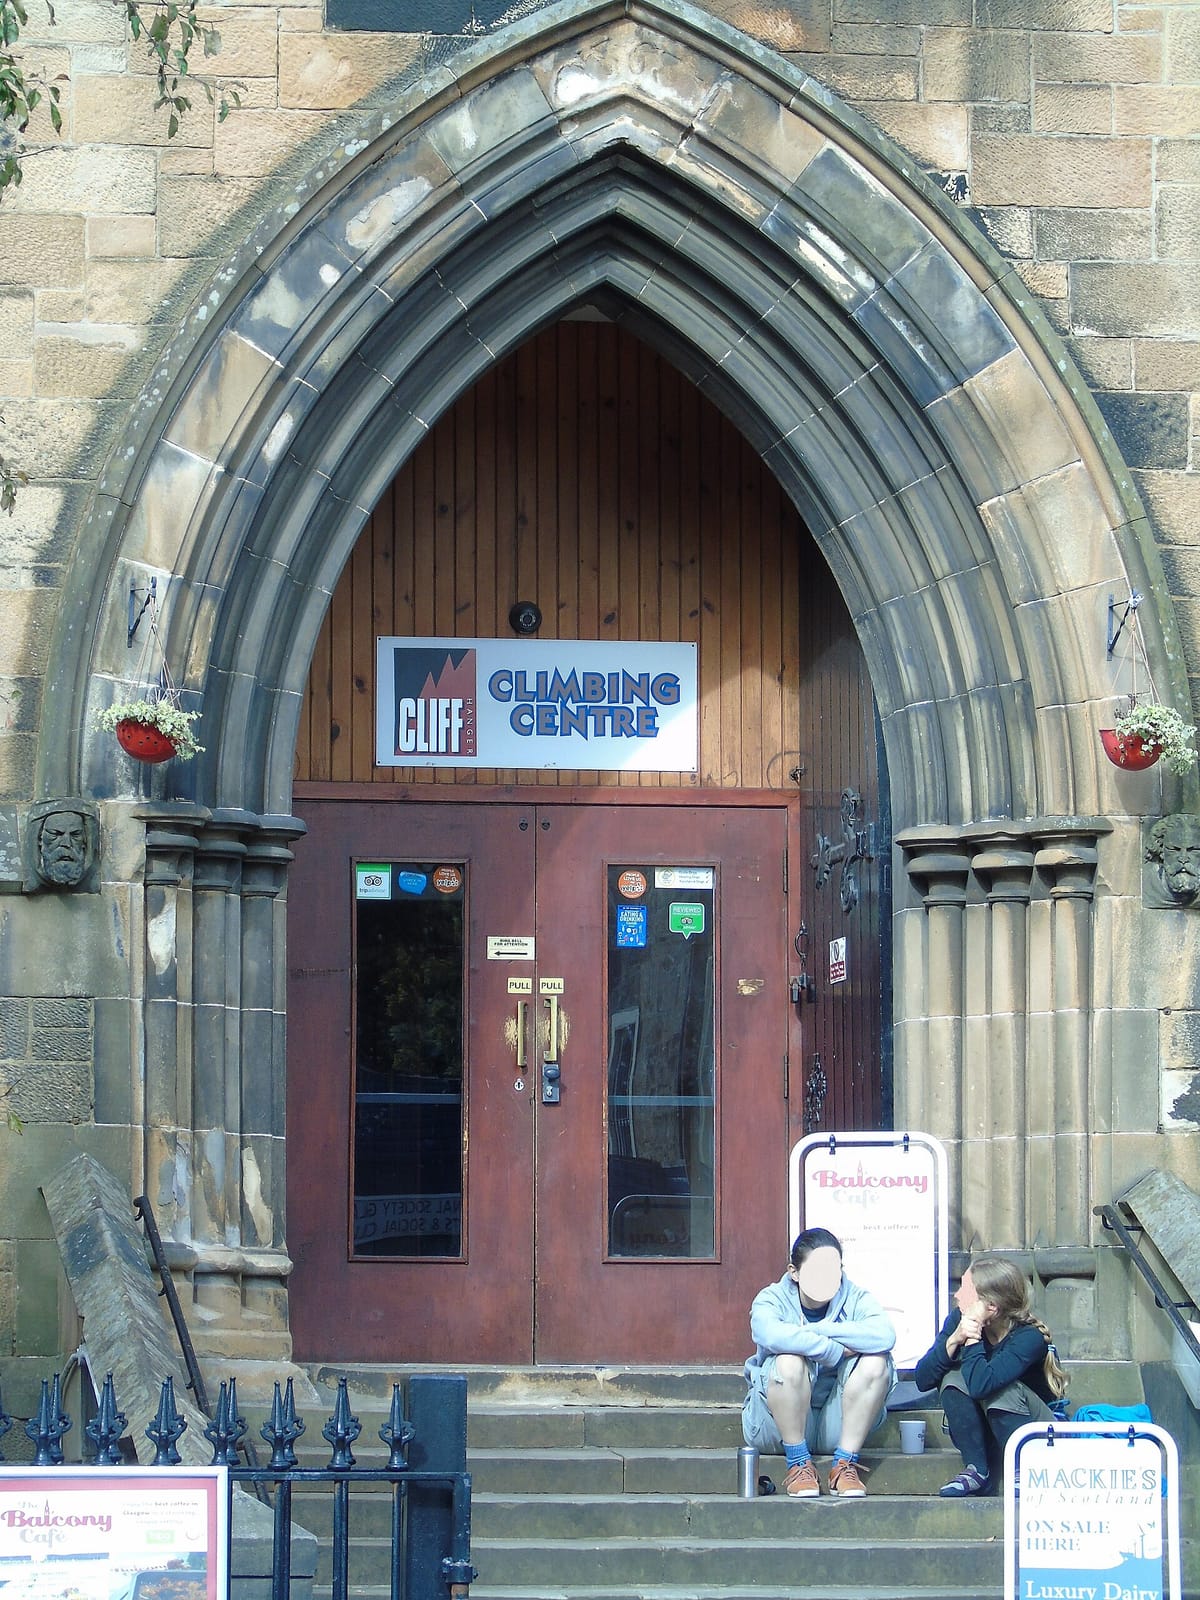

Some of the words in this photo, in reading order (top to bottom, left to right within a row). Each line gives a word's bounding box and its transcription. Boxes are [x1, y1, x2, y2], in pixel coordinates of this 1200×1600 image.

[488, 666, 681, 706] CLIMBING
[399, 697, 463, 753] CLIFF
[466, 698, 474, 755] HANGER
[509, 702, 660, 741] CENTRE
[509, 981, 531, 990] PULL
[541, 981, 563, 990] PULL
[811, 1165, 928, 1194] Balcony
[863, 1223, 881, 1231] best
[883, 1223, 909, 1231] coffee
[1057, 1491, 1155, 1505] Scotland
[0, 1505, 112, 1532] Balcony
[1026, 1519, 1054, 1534] ON
[1060, 1519, 1111, 1534] SALE
[19, 1527, 67, 1548] Café
[1026, 1537, 1081, 1551] HERE
[1025, 1580, 1096, 1600] Luxury
[1103, 1582, 1160, 1600] Dairy
